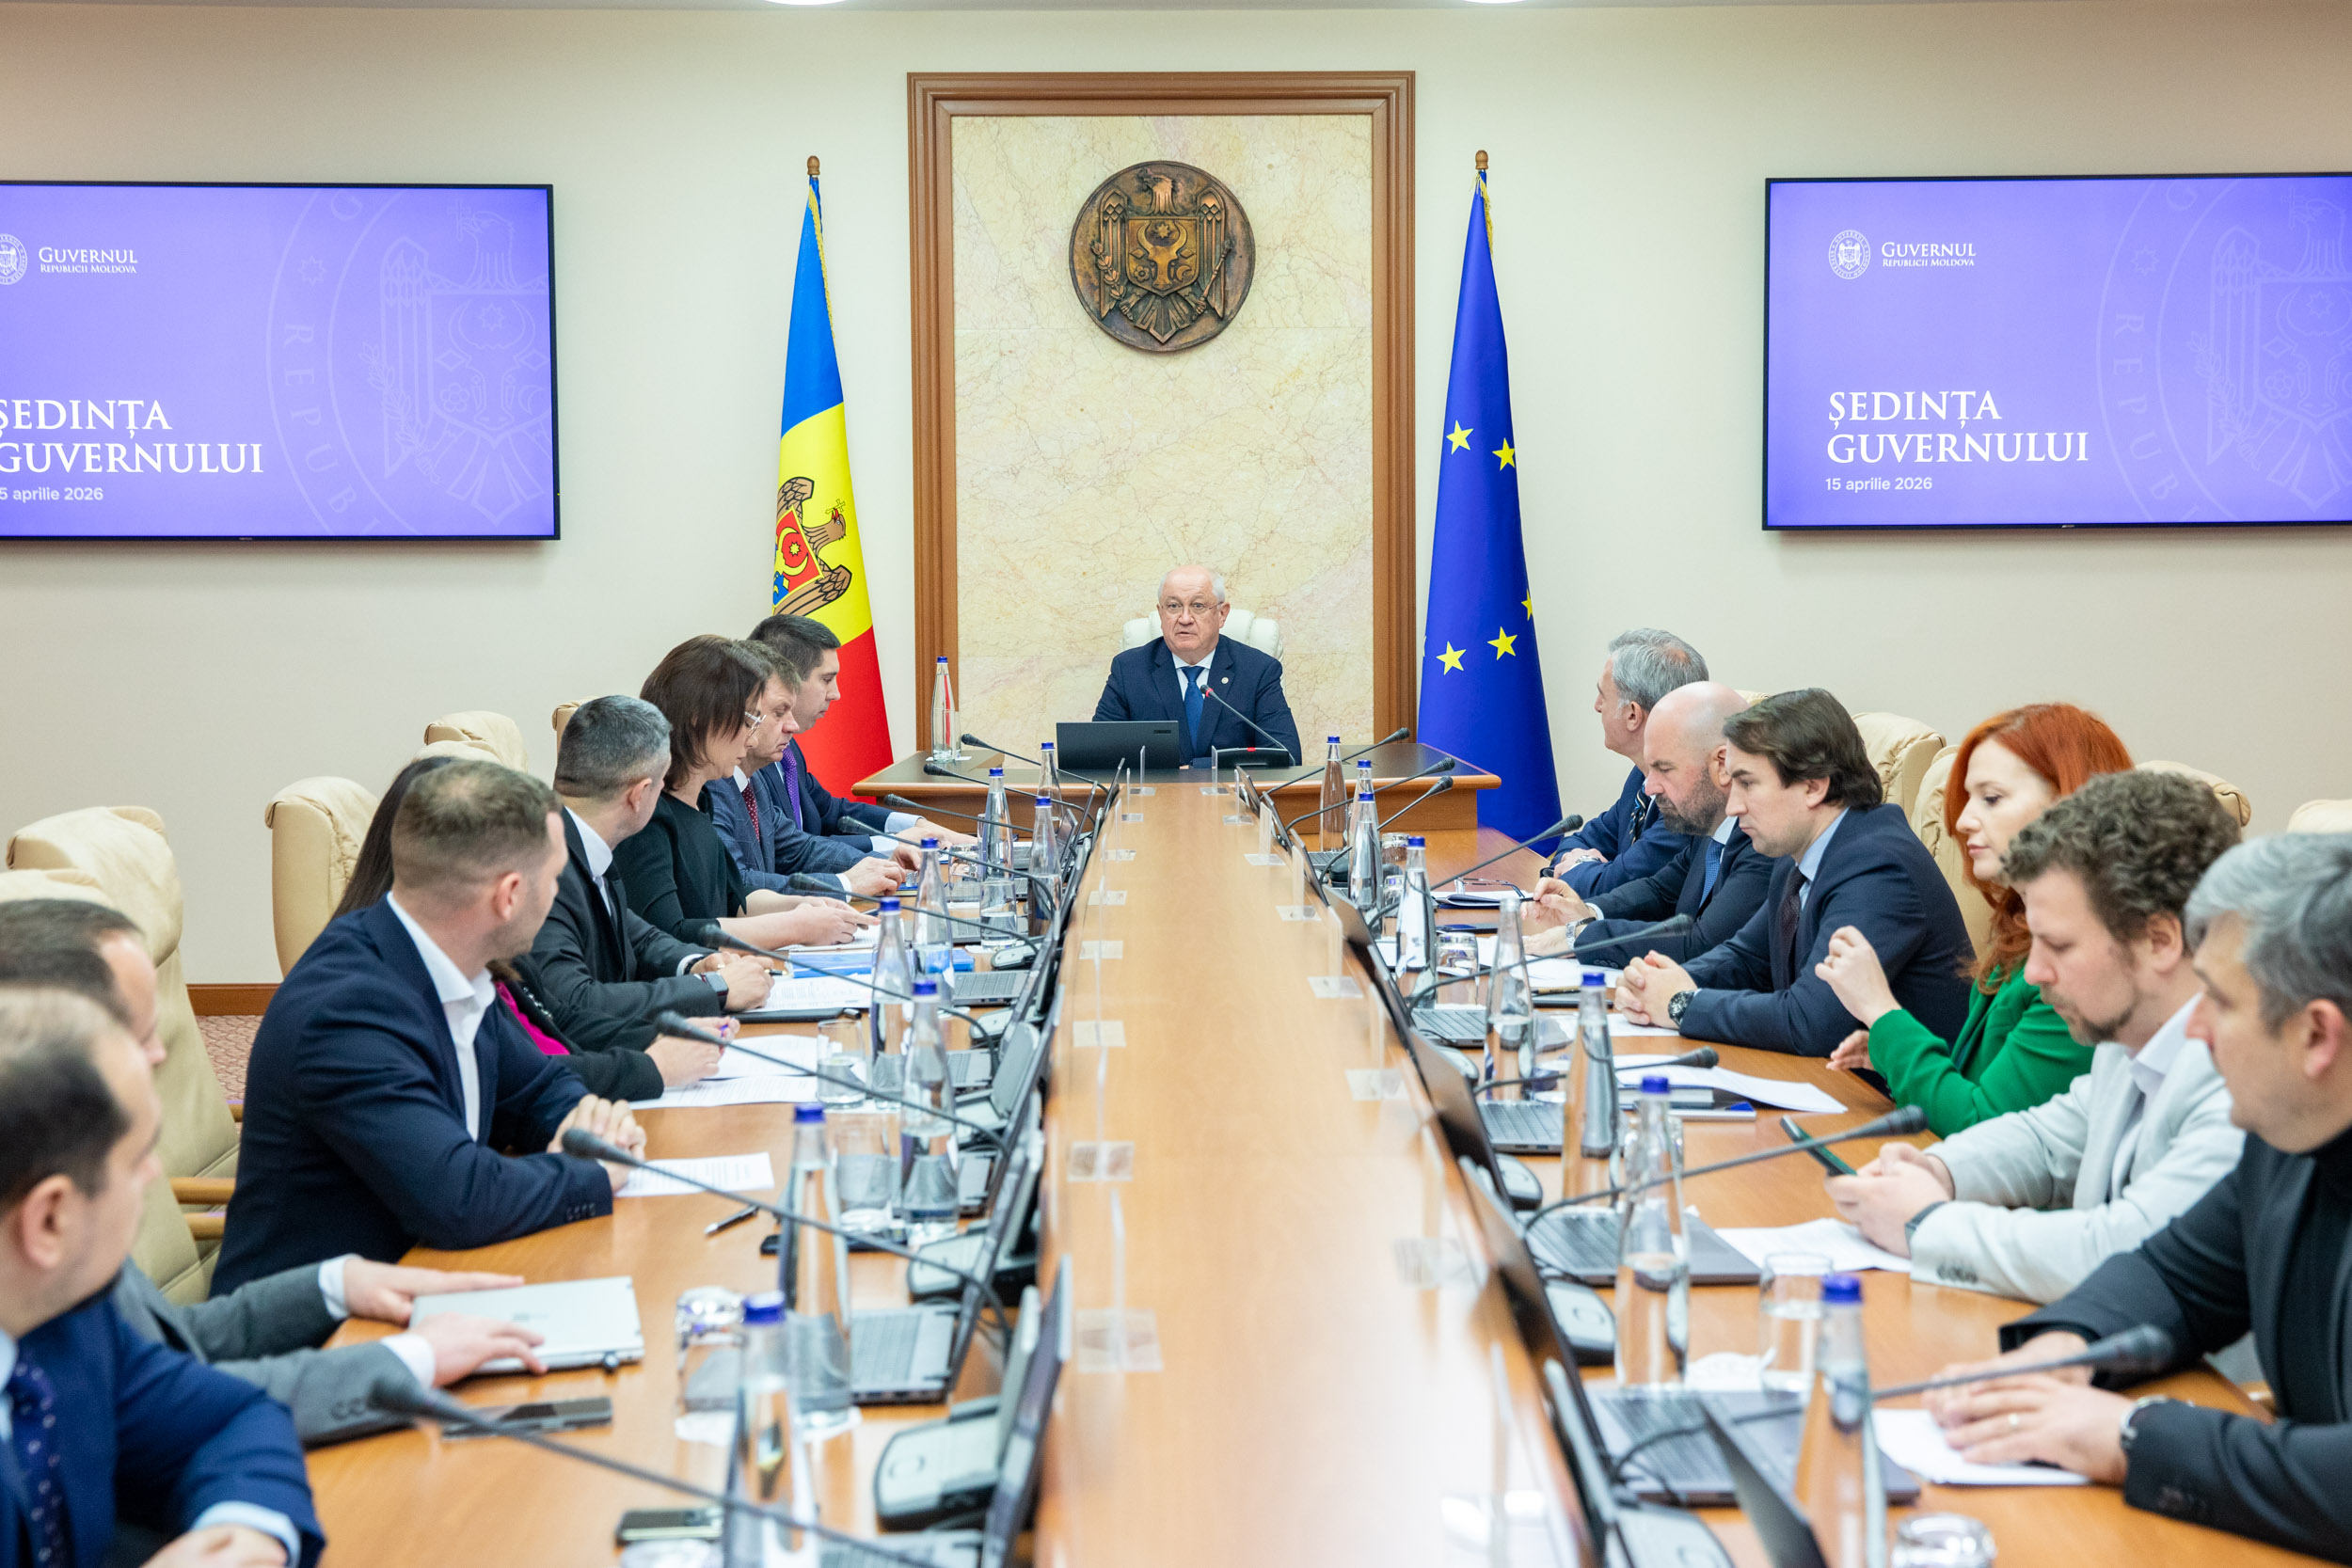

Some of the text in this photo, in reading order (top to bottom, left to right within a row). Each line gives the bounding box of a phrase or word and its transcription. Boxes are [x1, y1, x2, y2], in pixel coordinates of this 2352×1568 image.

[39, 246, 138, 263] GUVERNUL
[1881, 241, 1977, 258] GUVERNUL
[40, 264, 137, 274] REPUBLICII MOLDOVA
[1883, 258, 1975, 267] REPUBLICII MOLDOVA
[1828, 389, 2002, 430] ȘEDINȚA
[1827, 432, 2089, 464] GUVERNULUI
[0, 442, 264, 474] GUVERNULUI
[1825, 476, 1933, 493] 15 aprilie 2026
[0, 486, 103, 503] 5 aprilie 2026
